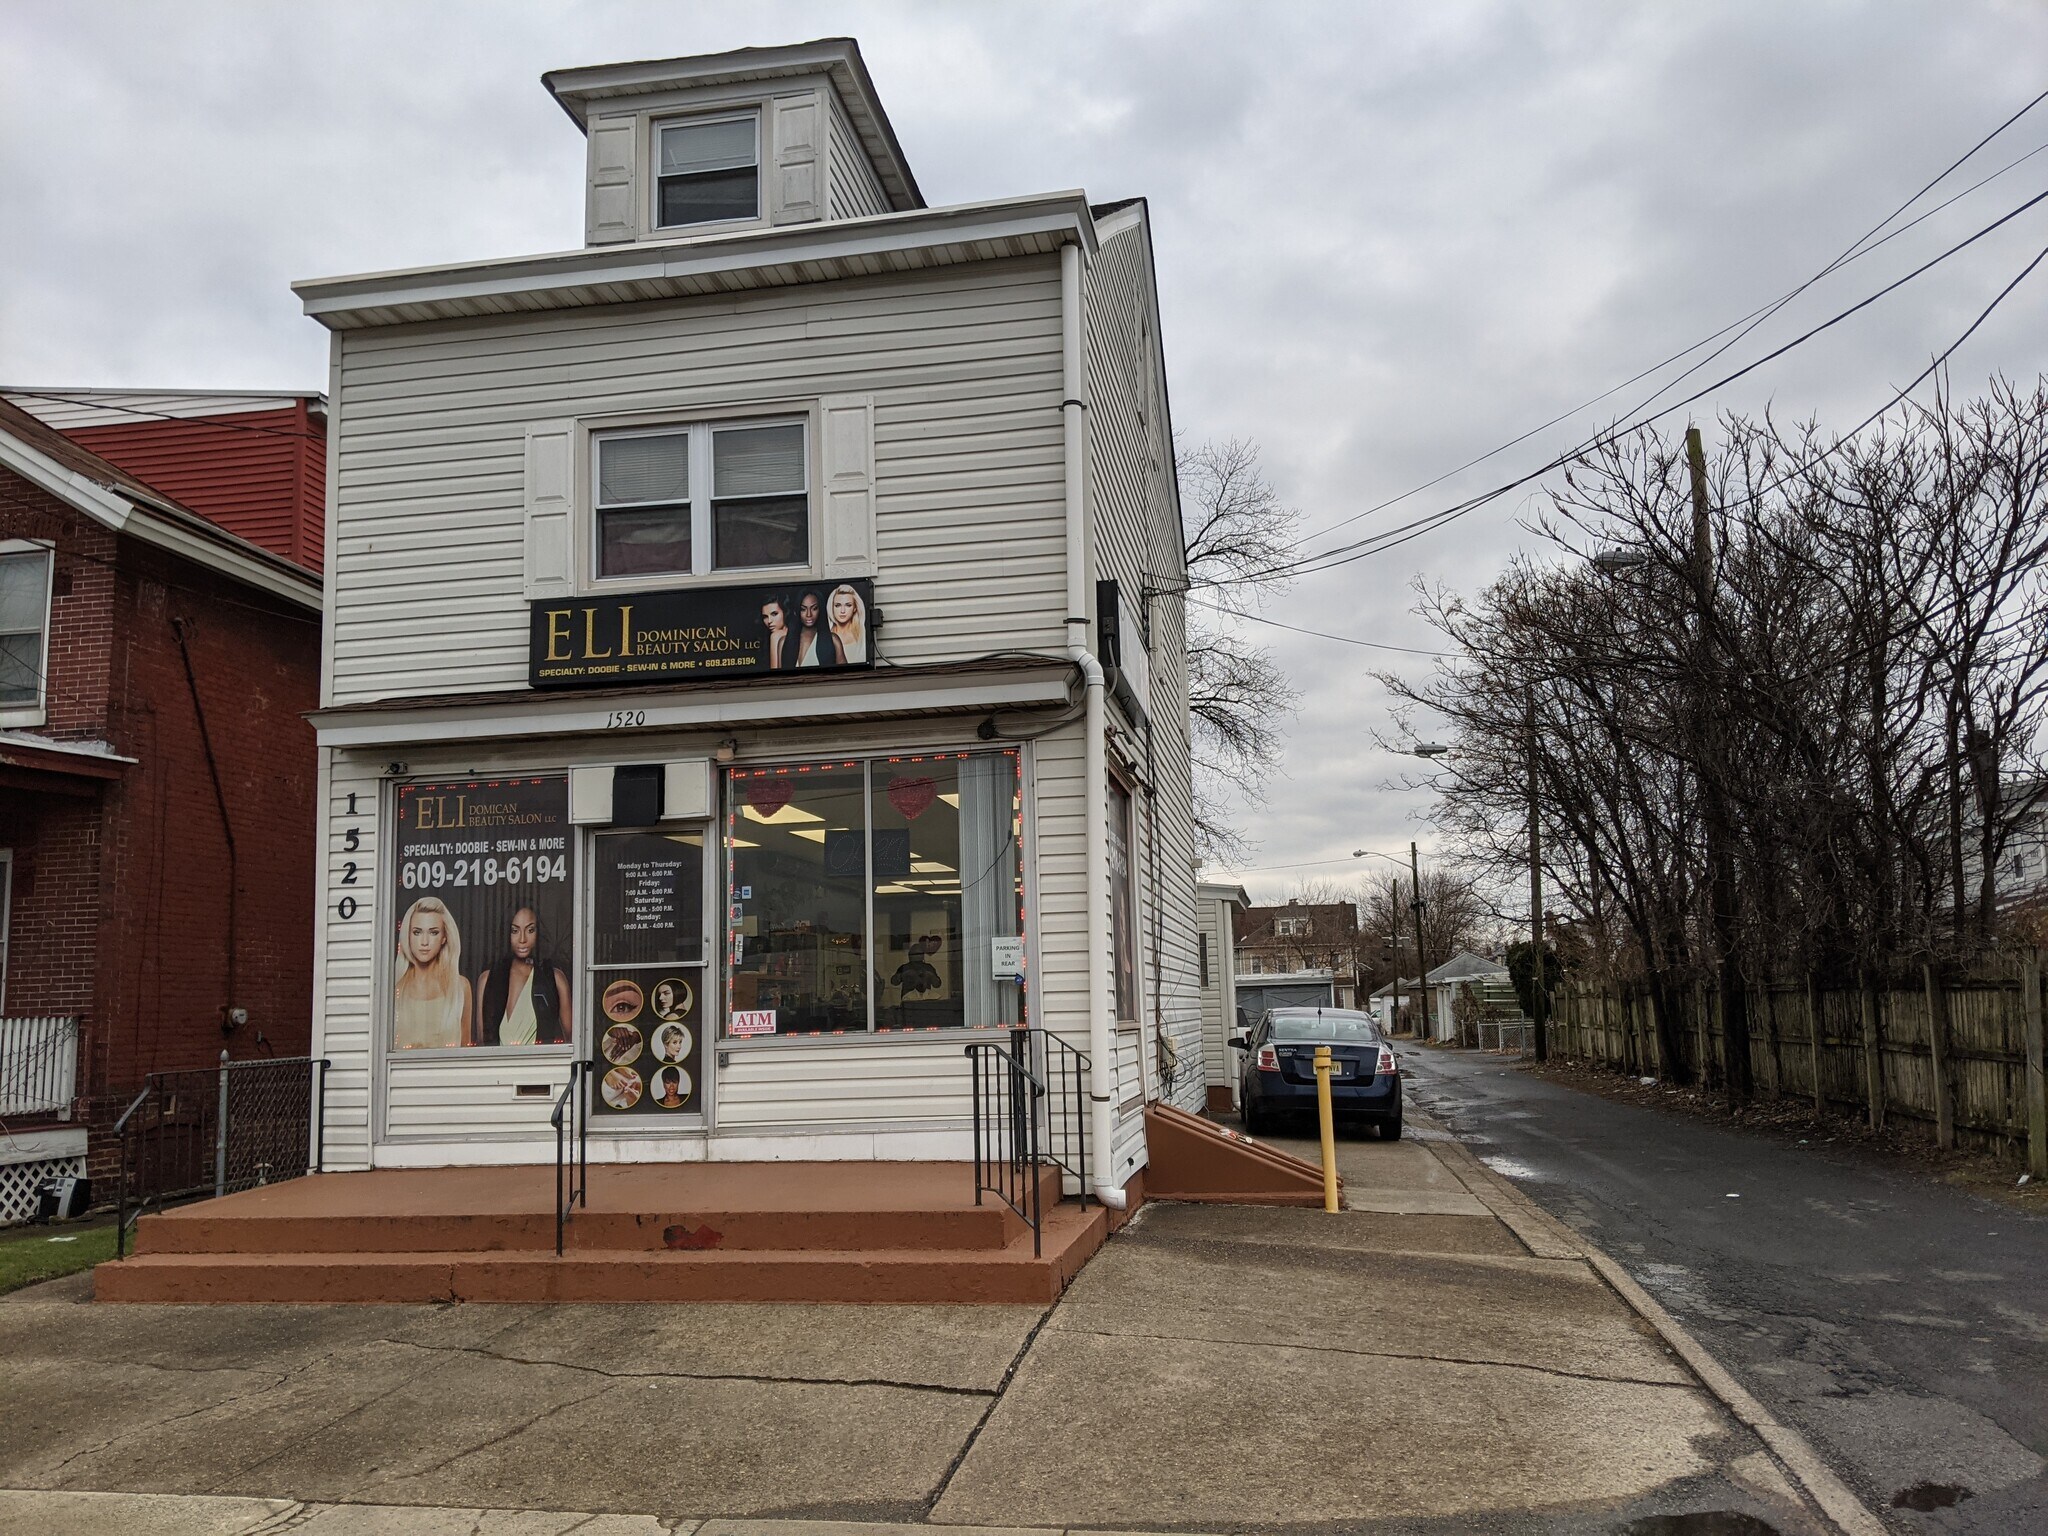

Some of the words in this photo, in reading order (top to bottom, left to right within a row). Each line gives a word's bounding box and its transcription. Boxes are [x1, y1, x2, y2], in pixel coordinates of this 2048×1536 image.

[544, 605, 635, 661] ELI
[637, 626, 727, 643] DOMINICAN
[637, 641, 690, 656] BEAUTY
[693, 638, 740, 653] SALON
[744, 640, 761, 650] LLC
[539, 667, 586, 677] SPECIALTY:
[588, 664, 620, 674] DOOBIE
[627, 662, 659, 672] SEW-IN
[661, 662, 667, 670] &
[669, 660, 696, 669] MORE
[607, 711, 645, 728] 1520
[415, 795, 467, 830] ELI
[469, 803, 517, 815] DOMICAN
[469, 815, 506, 827] BEAUTY
[508, 813, 542, 825] SALON
[544, 815, 556, 823] LLC
[403, 842, 454, 857] SPECIALTY:
[455, 841, 490, 854] DOOBIE
[496, 839, 528, 852] SEW-IN
[530, 839, 537, 850] &
[539, 837, 565, 850] MORE
[402, 855, 567, 889] 609-218-6194
[651, 861, 682, 869] Thursday:
[737, 1013, 772, 1026] ATM
